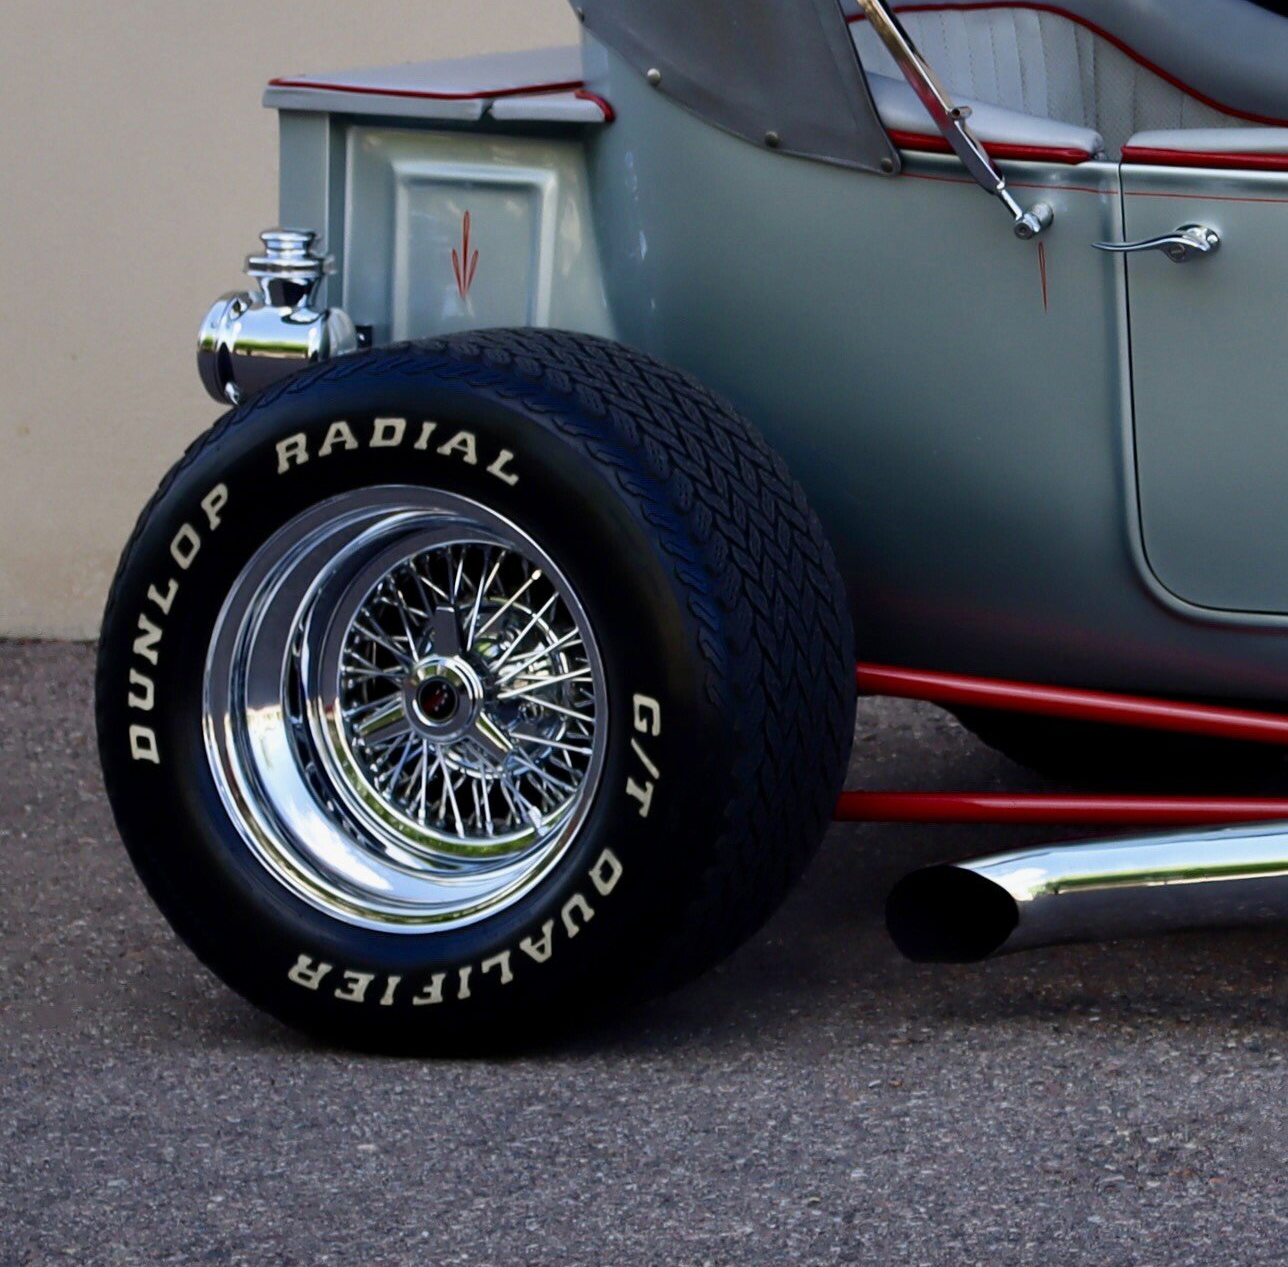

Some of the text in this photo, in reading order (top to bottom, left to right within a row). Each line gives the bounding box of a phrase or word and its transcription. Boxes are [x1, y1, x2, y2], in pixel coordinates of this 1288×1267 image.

[127, 417, 521, 766] DUNLOP RADIAL
[287, 692, 662, 1007] G/T QUALIFIER
